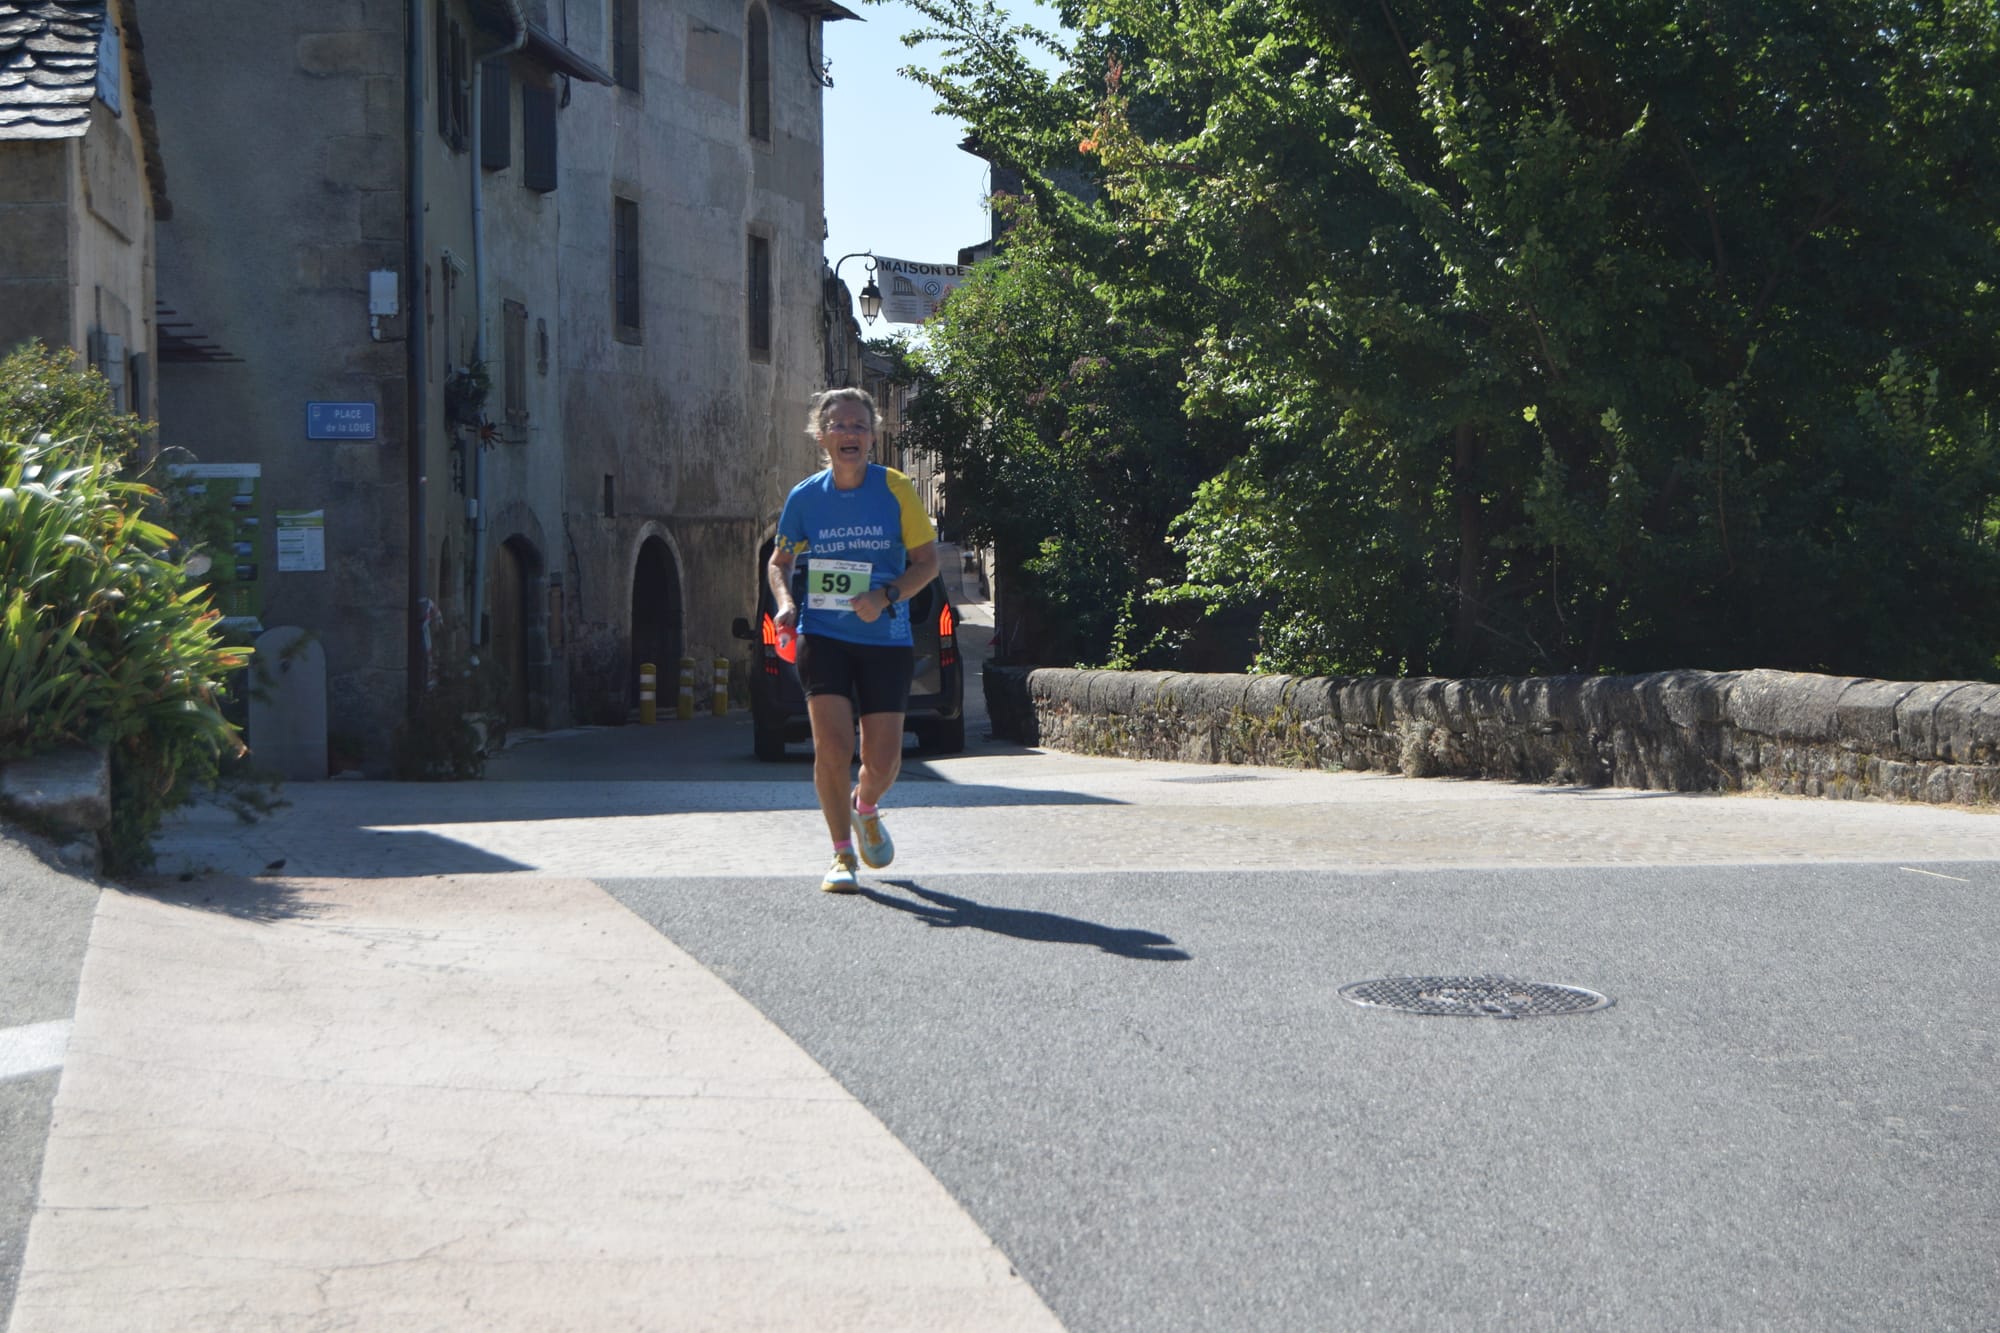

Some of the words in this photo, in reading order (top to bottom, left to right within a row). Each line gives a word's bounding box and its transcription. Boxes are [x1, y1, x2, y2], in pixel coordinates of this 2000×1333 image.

[880, 260, 941, 275] MAISON
[946, 266, 966, 277] DE
[335, 409, 362, 419] PLACE
[326, 423, 336, 433] de
[338, 423, 346, 433] la
[349, 423, 371, 433] LOUE
[819, 525, 884, 540] MACADAM
[814, 541, 846, 554] CLUB
[822, 573, 851, 593] 59
